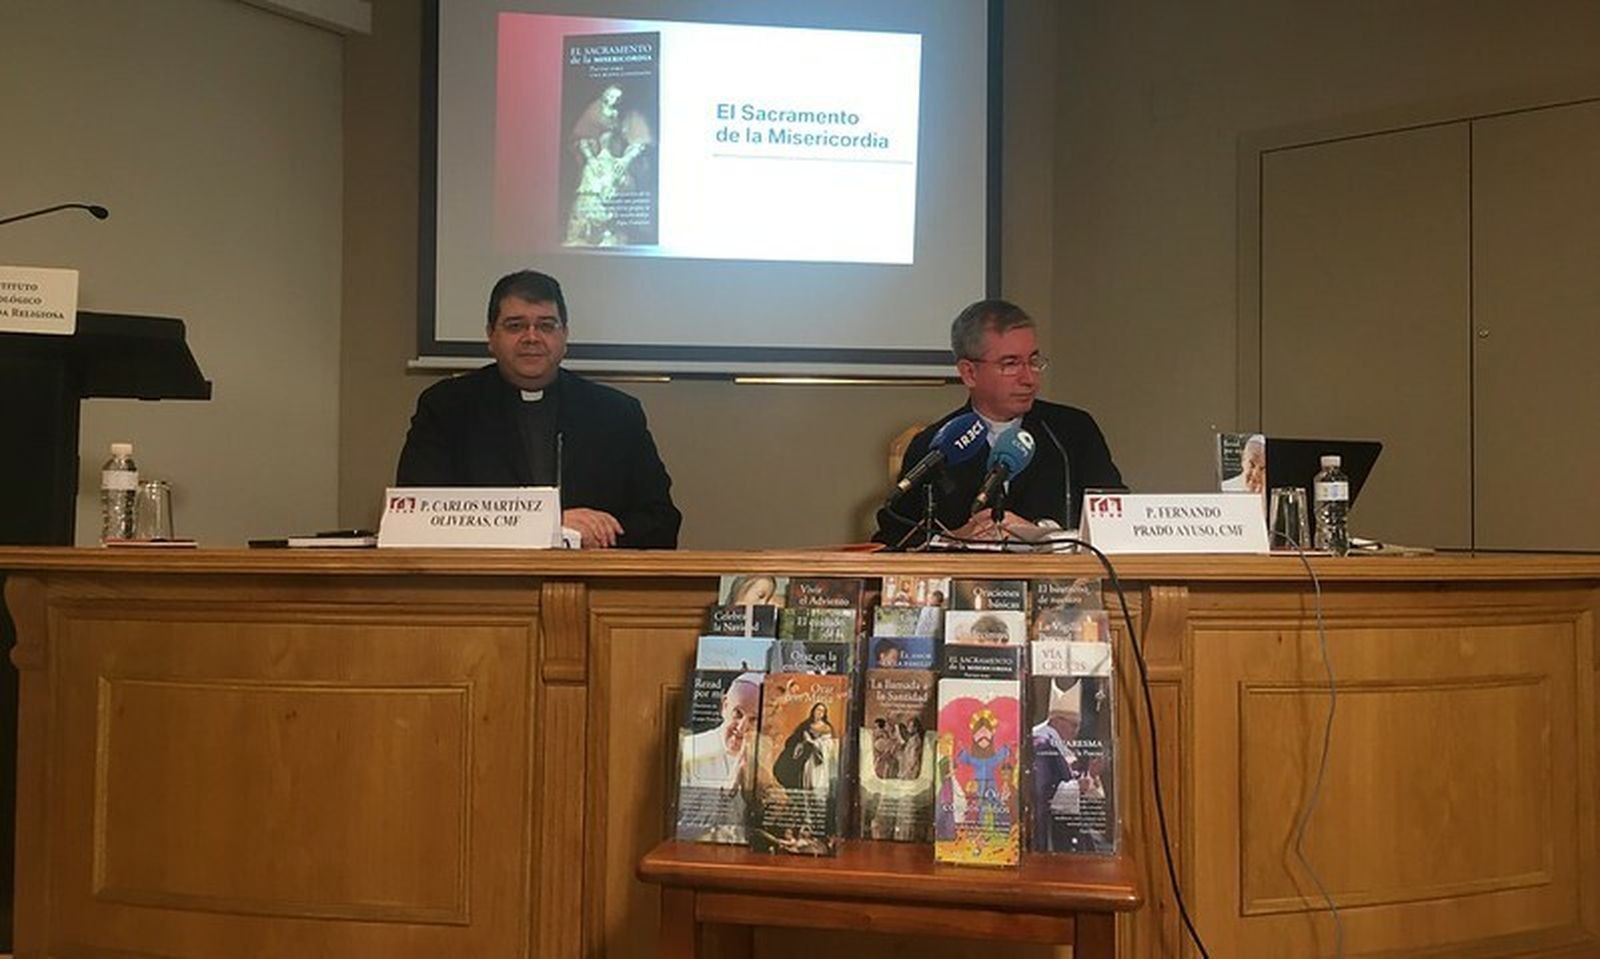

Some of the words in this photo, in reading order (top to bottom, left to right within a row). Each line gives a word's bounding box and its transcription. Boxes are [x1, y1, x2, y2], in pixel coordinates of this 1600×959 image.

[717, 103, 735, 120] El
[742, 104, 859, 125] Sacramento
[716, 127, 740, 143] de
[746, 127, 762, 144] la
[768, 128, 889, 149] Misericordia
[432, 500, 479, 512] CARLOS
[482, 496, 543, 512] MARTÍNEZ
[1158, 507, 1221, 519] FERNANDO
[1133, 525, 1173, 537] PRADO
[972, 586, 1020, 598] Oraciones
[808, 595, 850, 606] Adviento
[723, 621, 760, 632] Naviad
[694, 677, 722, 689] Rezad
[693, 690, 710, 701] por
[887, 690, 929, 702] Santidad
